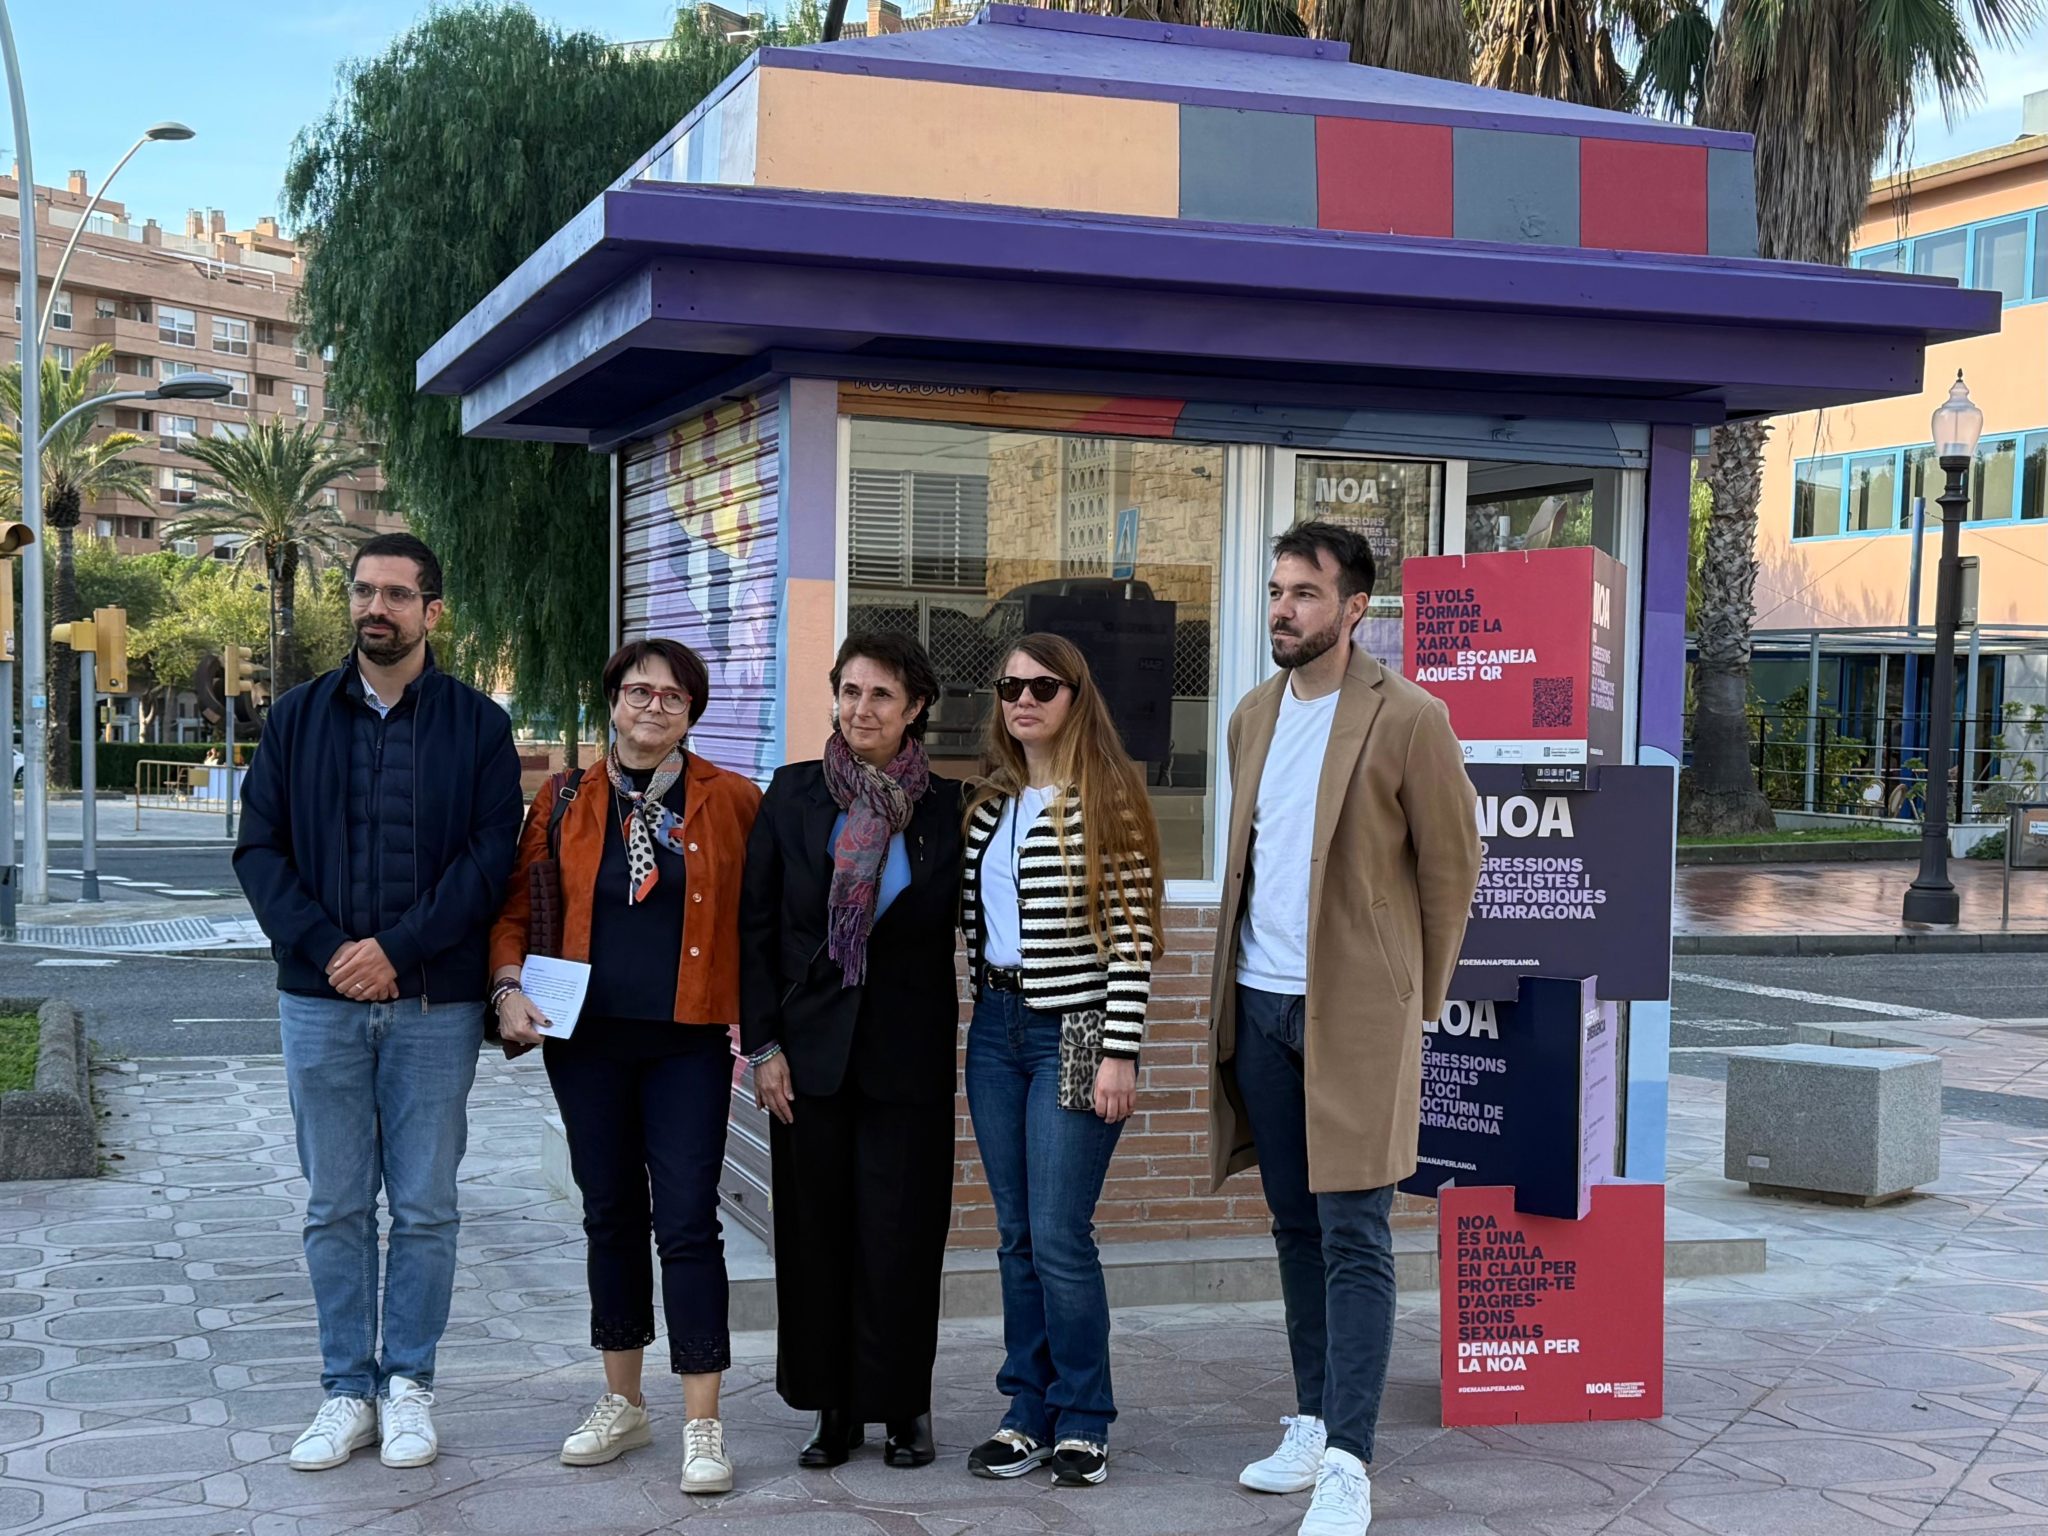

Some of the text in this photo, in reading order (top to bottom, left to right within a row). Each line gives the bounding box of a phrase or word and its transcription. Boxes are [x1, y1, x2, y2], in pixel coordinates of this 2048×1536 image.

[1315, 477, 1379, 503] NOA
[1416, 588, 1475, 605] SI VOLS
[1416, 604, 1482, 620] FORMAR
[1593, 581, 1610, 630] NOA
[1416, 618, 1502, 635] PART DE LA
[1416, 636, 1471, 651] XARXA
[1416, 648, 1537, 668] NOA, ESCANEJA
[1416, 665, 1502, 682] AQUEST QR
[1475, 795, 1574, 838] NOA
[1480, 841, 1490, 856] O
[1479, 857, 1583, 872] GRESSIONS
[1477, 873, 1590, 888] ASCLISTES I
[1472, 887, 1607, 904] GTBIFÒBIQUES
[1479, 904, 1596, 919] TARRAGONA
[1458, 958, 1540, 967] #DEMANAPERLANOA
[1423, 1000, 1499, 1040] OA
[1421, 1035, 1433, 1050] O
[1421, 1051, 1507, 1074] GRESSIONS
[1421, 1066, 1479, 1086] EXUALS
[1425, 1081, 1461, 1099] L'OCI
[1420, 1096, 1504, 1120] OCTURN DE
[1419, 1110, 1501, 1136] ARRAGONA
[1417, 1155, 1477, 1171] EMANAPERLANOA
[1458, 1215, 1497, 1230] NOA
[1458, 1229, 1526, 1246] ÉS UNA
[1458, 1246, 1544, 1262] PARAULA
[1458, 1261, 1577, 1277] EN CLAU PER
[1458, 1276, 1575, 1293] PROTEGIR-TE
[1458, 1293, 1542, 1309] D'AGRES-
[1458, 1309, 1515, 1325] SIONS
[1458, 1324, 1544, 1341] SEXUALS
[1458, 1338, 1580, 1357] DEMANA PER
[1458, 1356, 1527, 1373] LA NOA
[1458, 1384, 1525, 1394] #DEMANAPERLANOA
[1586, 1382, 1612, 1394] NOA
